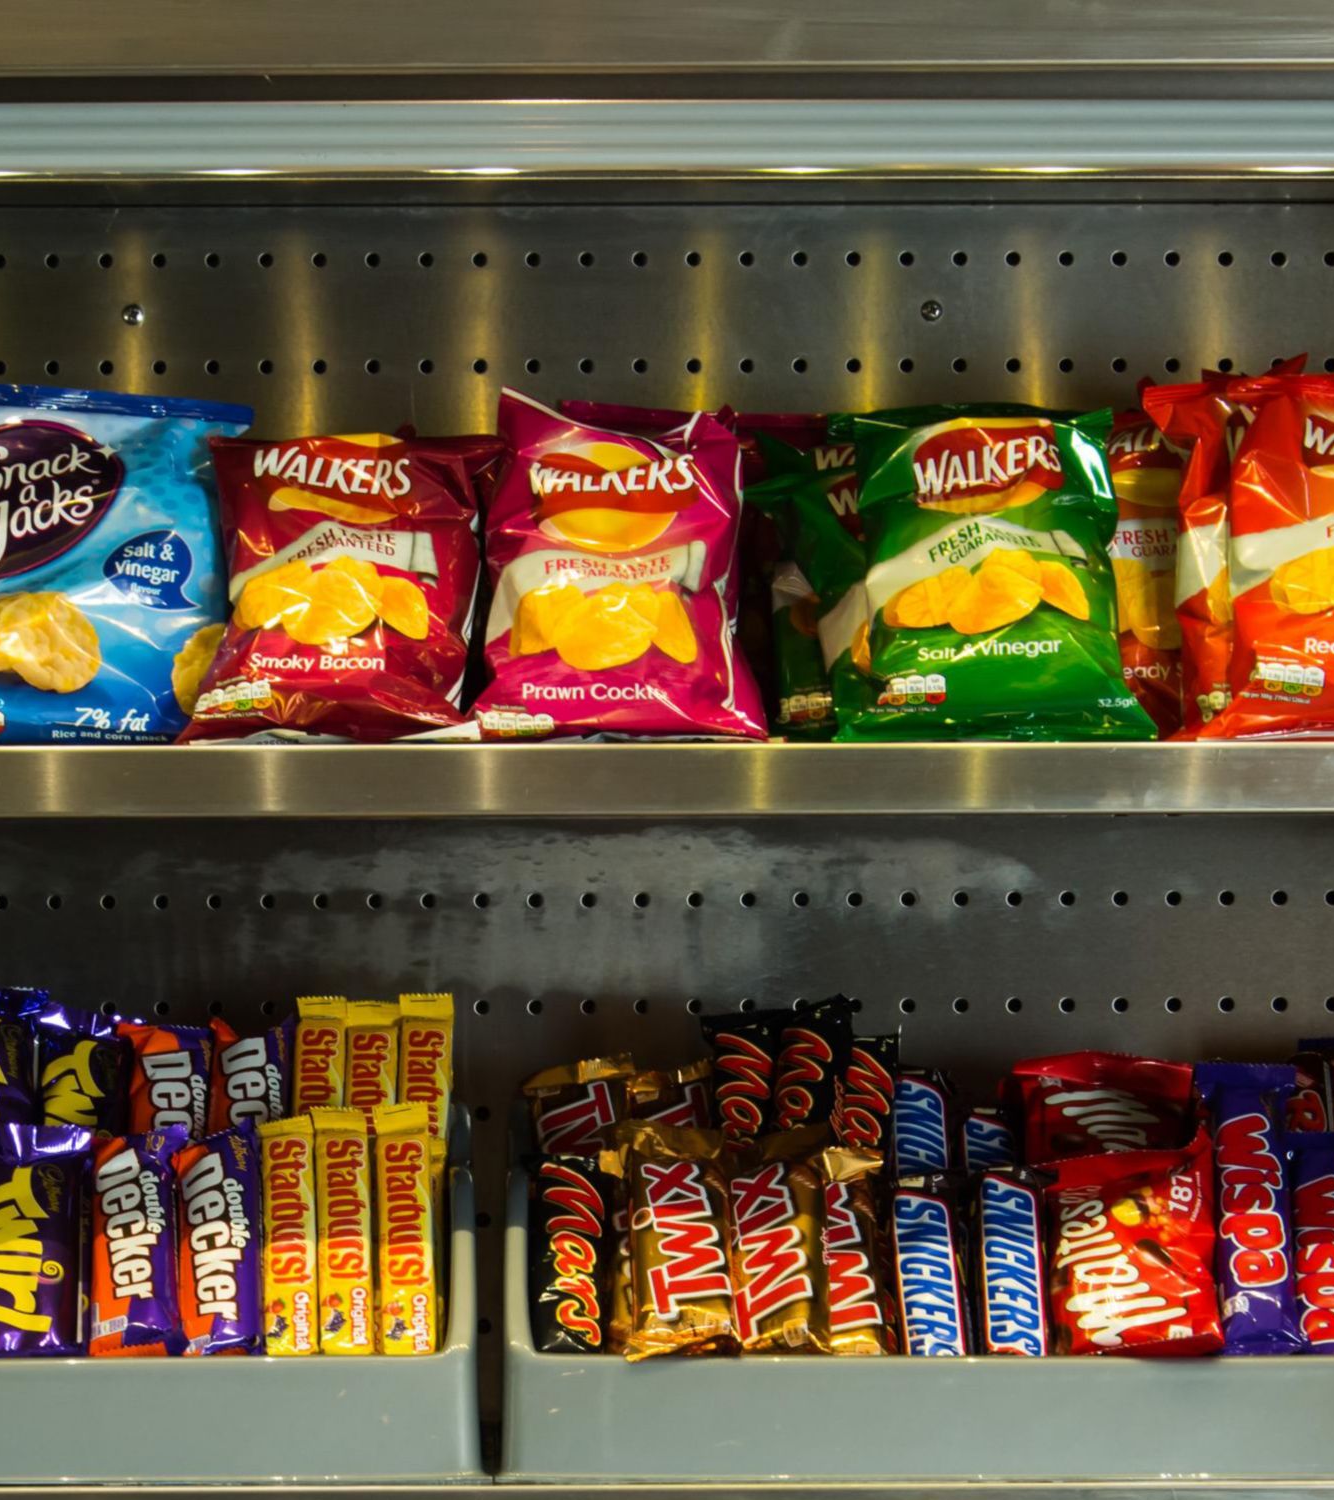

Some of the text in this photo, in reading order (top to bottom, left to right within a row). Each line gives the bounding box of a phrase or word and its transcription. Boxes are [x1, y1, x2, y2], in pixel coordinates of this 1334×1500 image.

[252, 446, 411, 499] WALKERS
[529, 453, 695, 496] WALKERS
[913, 435, 1064, 496] WALKERS
[123, 542, 175, 562] salt &
[928, 521, 981, 563] FRESH
[114, 560, 181, 586] vinegar
[249, 650, 385, 674] Smoky Bacon
[917, 639, 1063, 662] Salt Vinegar
[74, 706, 151, 732] 7% fat
[522, 683, 585, 700] Prawn
[139, 1169, 167, 1237] double
[221, 1177, 251, 1250] double
[268, 1138, 312, 1286] Starburst
[325, 1139, 368, 1281] Starburst
[384, 1141, 431, 1287] Starburst
[1168, 1174, 1194, 1213] 187
[1216, 1112, 1289, 1289] Wispa
[95, 1148, 158, 1301] Decker
[181, 1153, 242, 1324] Decker
[542, 1162, 606, 1347] Mars
[981, 1179, 1043, 1356] SNICKERS
[292, 1290, 311, 1353] Original
[350, 1286, 368, 1346] Original
[410, 1293, 428, 1353] Original
